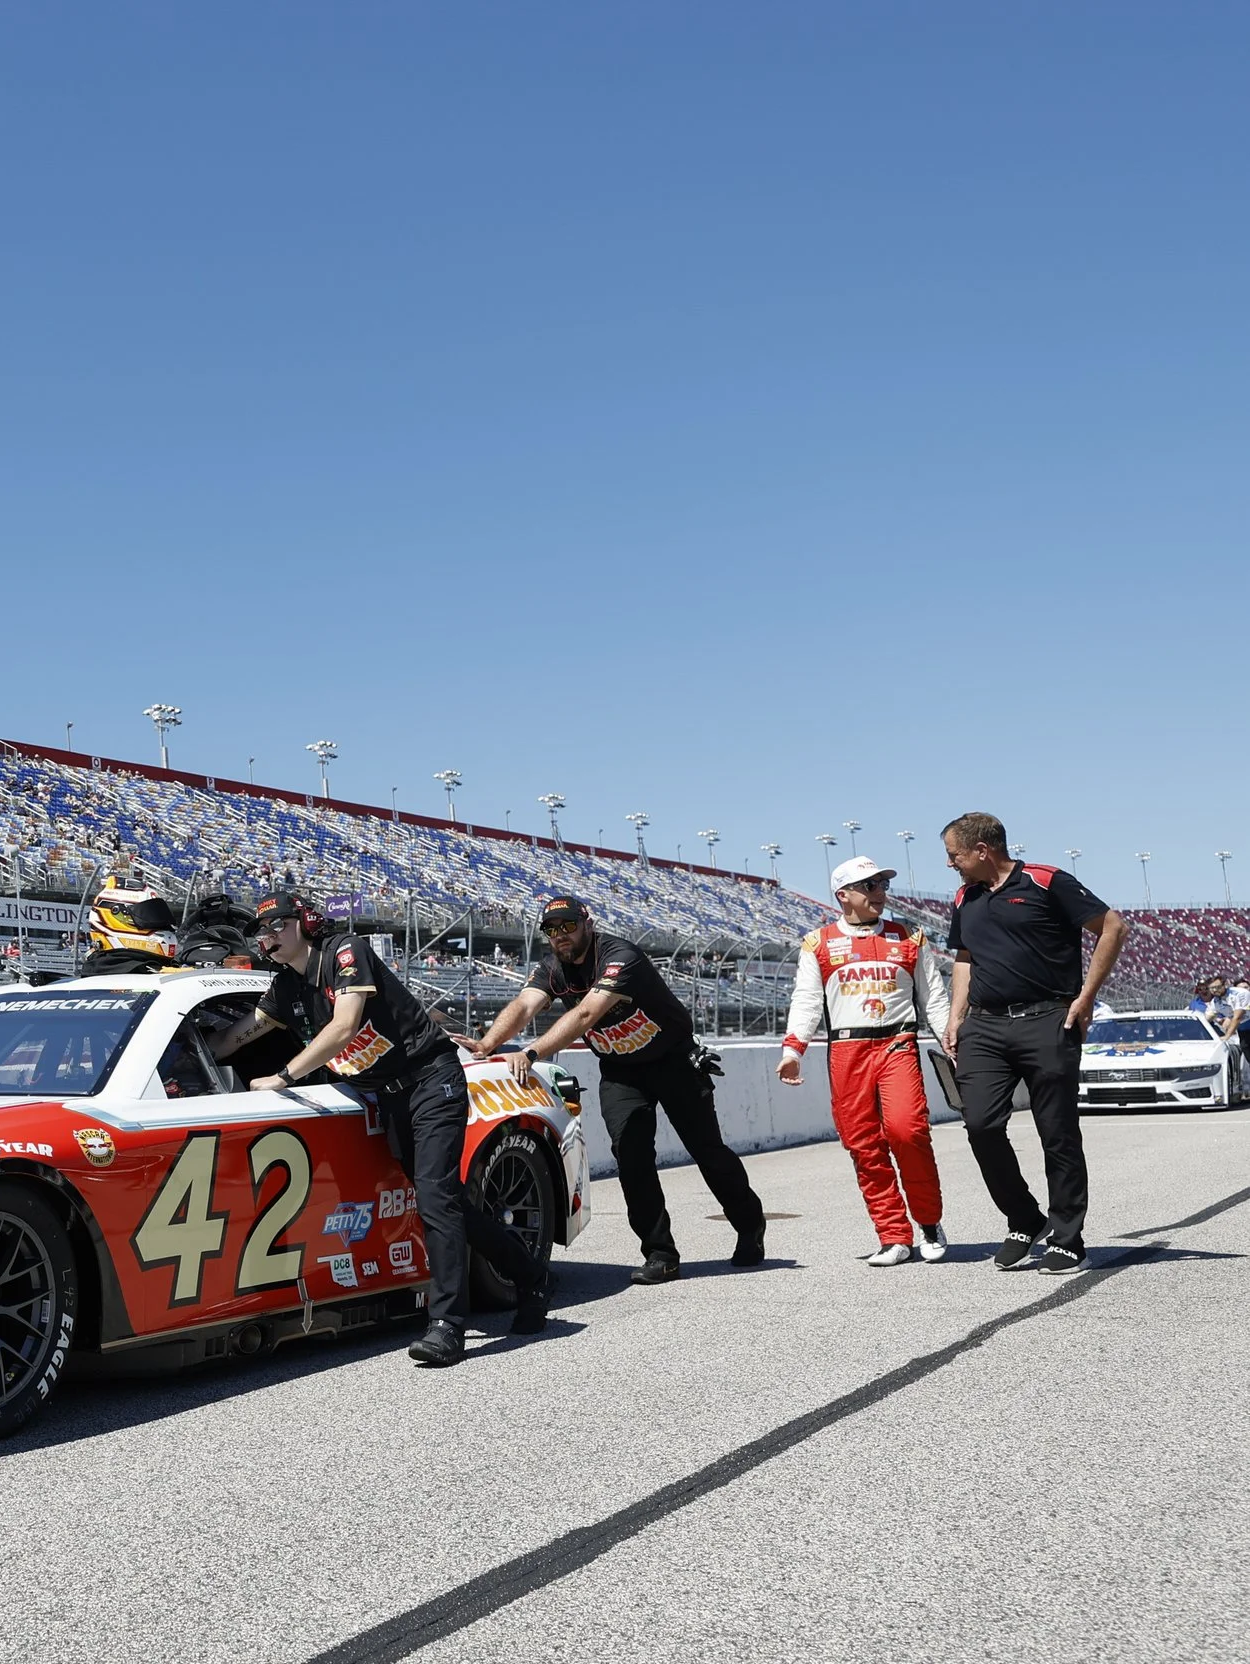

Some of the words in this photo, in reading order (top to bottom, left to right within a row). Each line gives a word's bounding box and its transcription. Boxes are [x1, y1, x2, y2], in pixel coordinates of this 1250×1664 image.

[837, 966, 900, 983] FAMILY
[840, 981, 898, 996] DOLLAR
[603, 1009, 649, 1041] FAMILY
[324, 1211, 357, 1231] PETTY
[354, 1203, 373, 1230] 75
[378, 1188, 406, 1219] PB
[130, 1126, 312, 1310] 42
[334, 1258, 351, 1270] DC8
[361, 1261, 380, 1276] SEM
[37, 1312, 75, 1400] EAGLE
